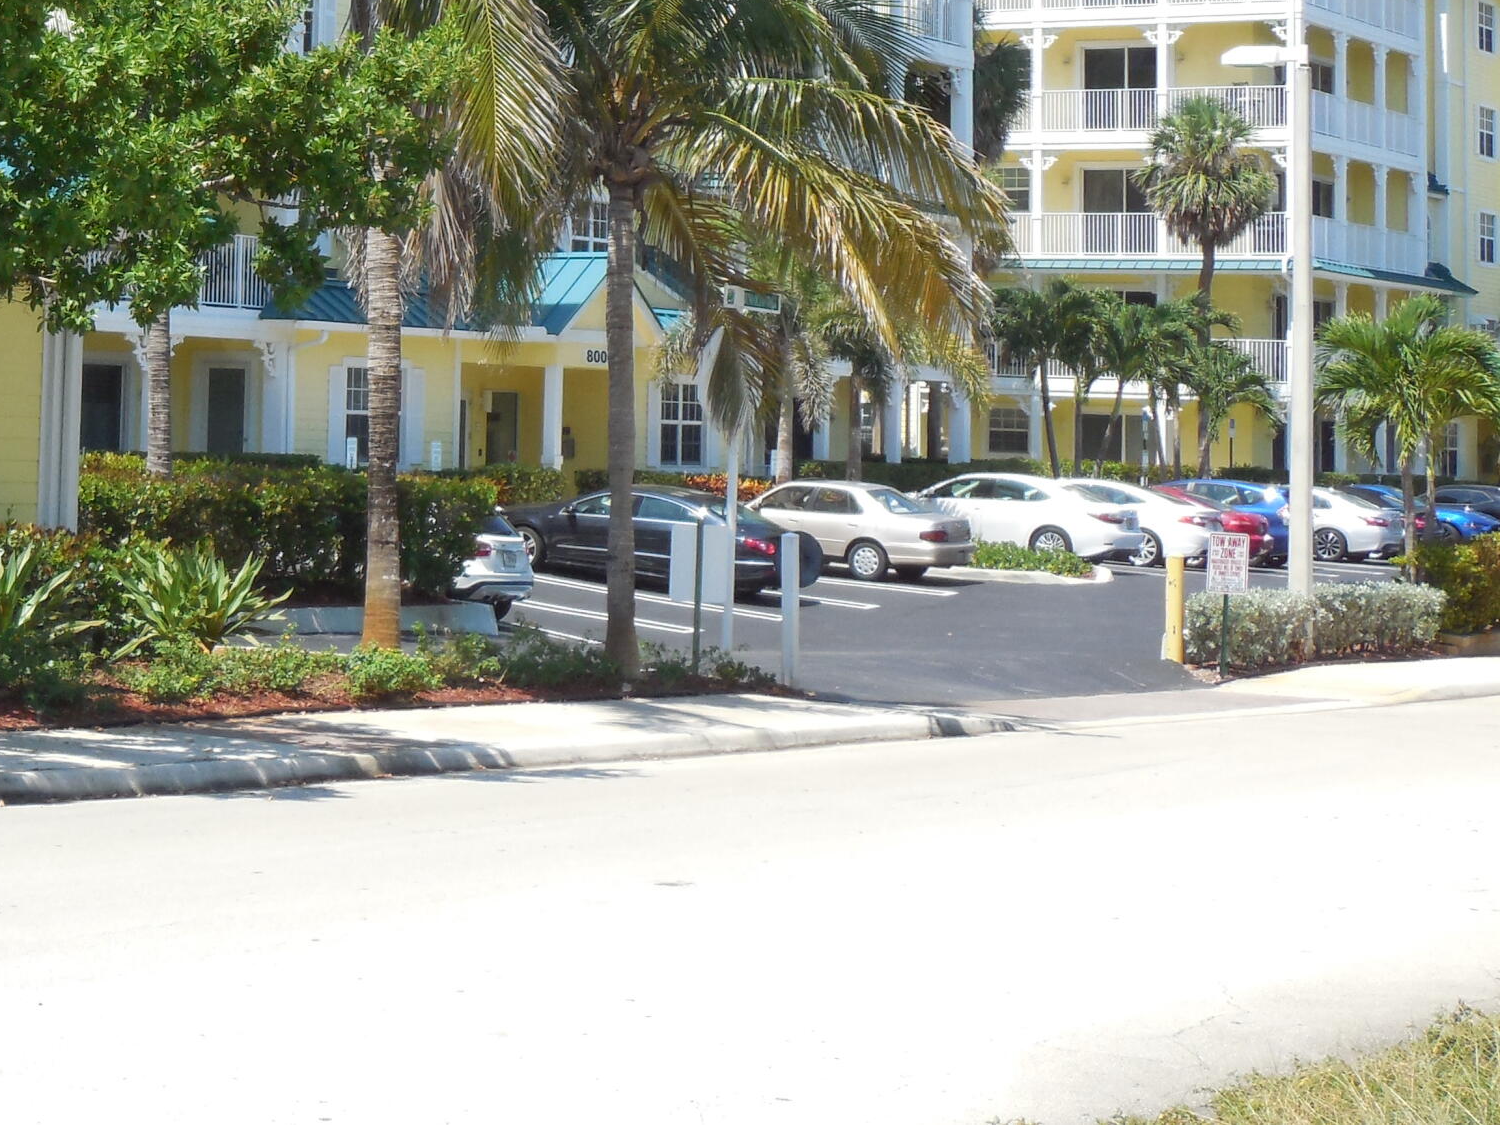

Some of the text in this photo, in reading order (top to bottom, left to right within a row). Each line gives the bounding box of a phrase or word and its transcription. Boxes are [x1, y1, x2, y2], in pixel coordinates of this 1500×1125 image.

[586, 349, 607, 364] 800
[1212, 535, 1246, 548] TOW AWAY
[1220, 547, 1236, 559] ZONE
